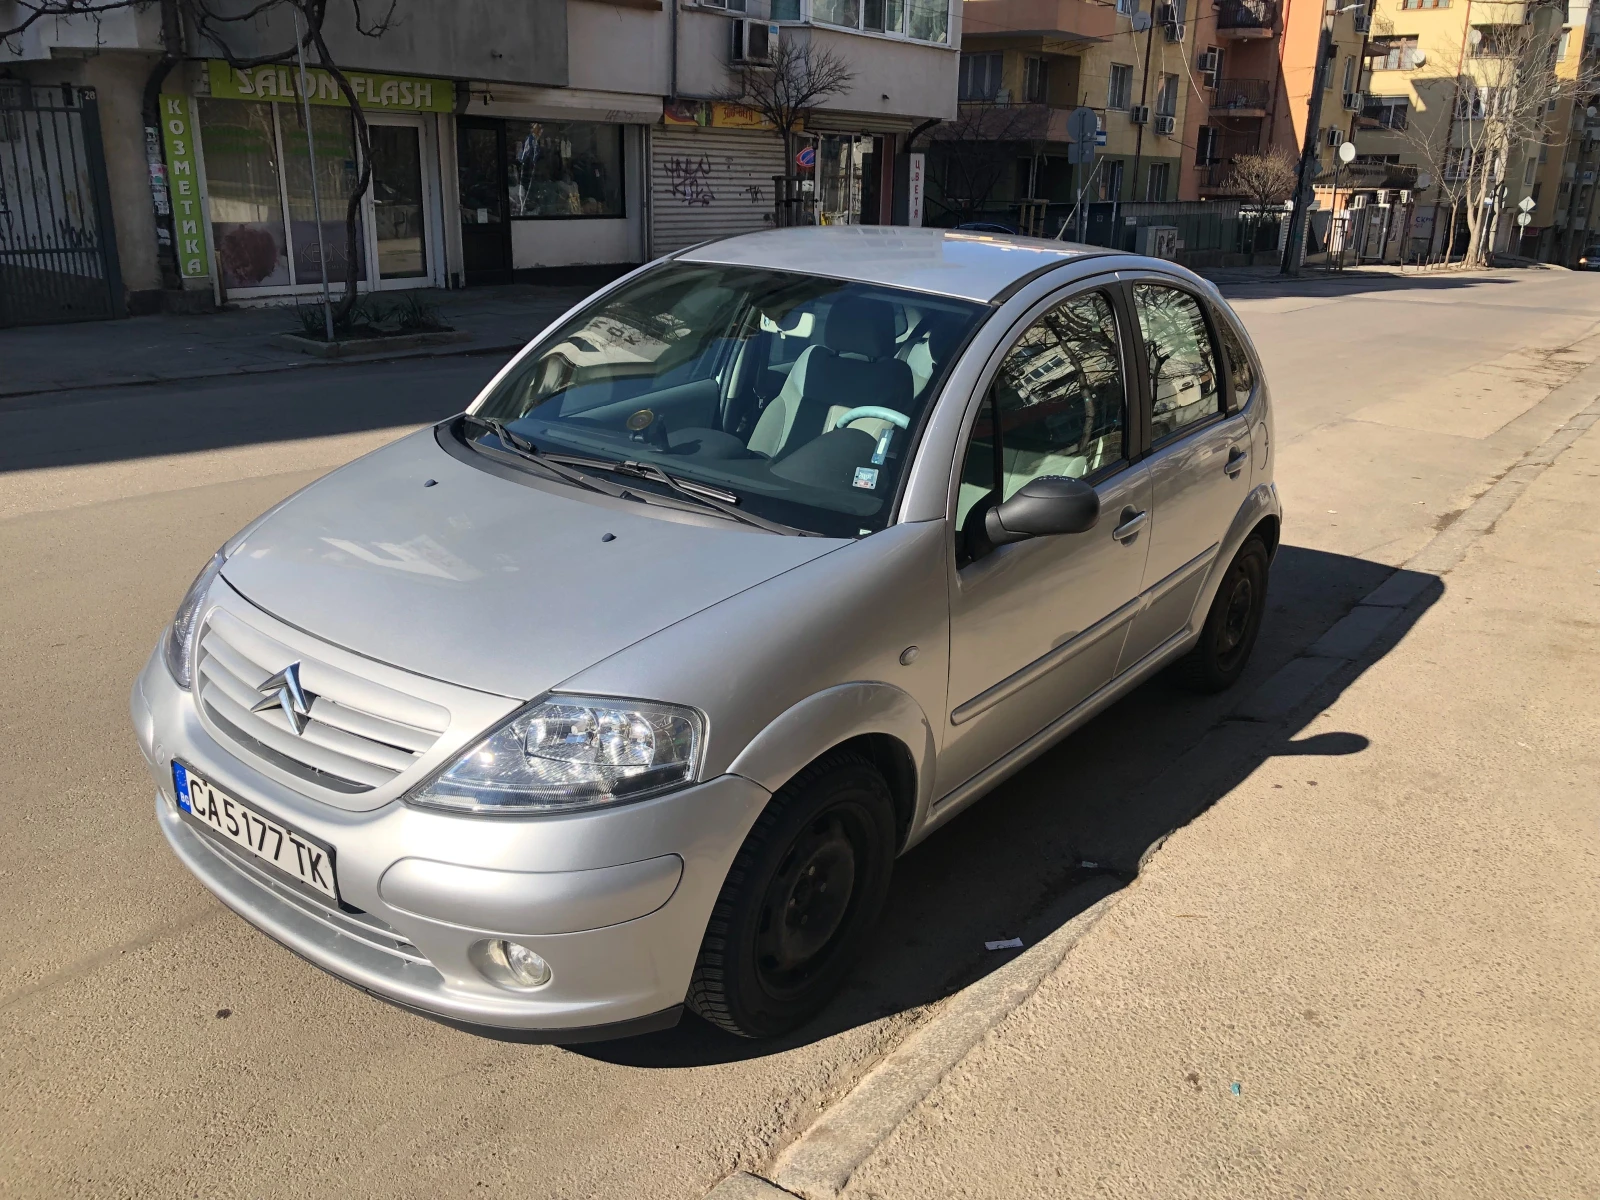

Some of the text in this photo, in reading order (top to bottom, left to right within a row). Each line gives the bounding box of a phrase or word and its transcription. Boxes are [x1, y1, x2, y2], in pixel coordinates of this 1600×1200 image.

[236, 68, 432, 109] SALON FLASH
[167, 99, 202, 275] КОЗМЕТИКА
[913, 159, 921, 219] ЦВЕТЯ
[179, 792, 190, 806] BG
